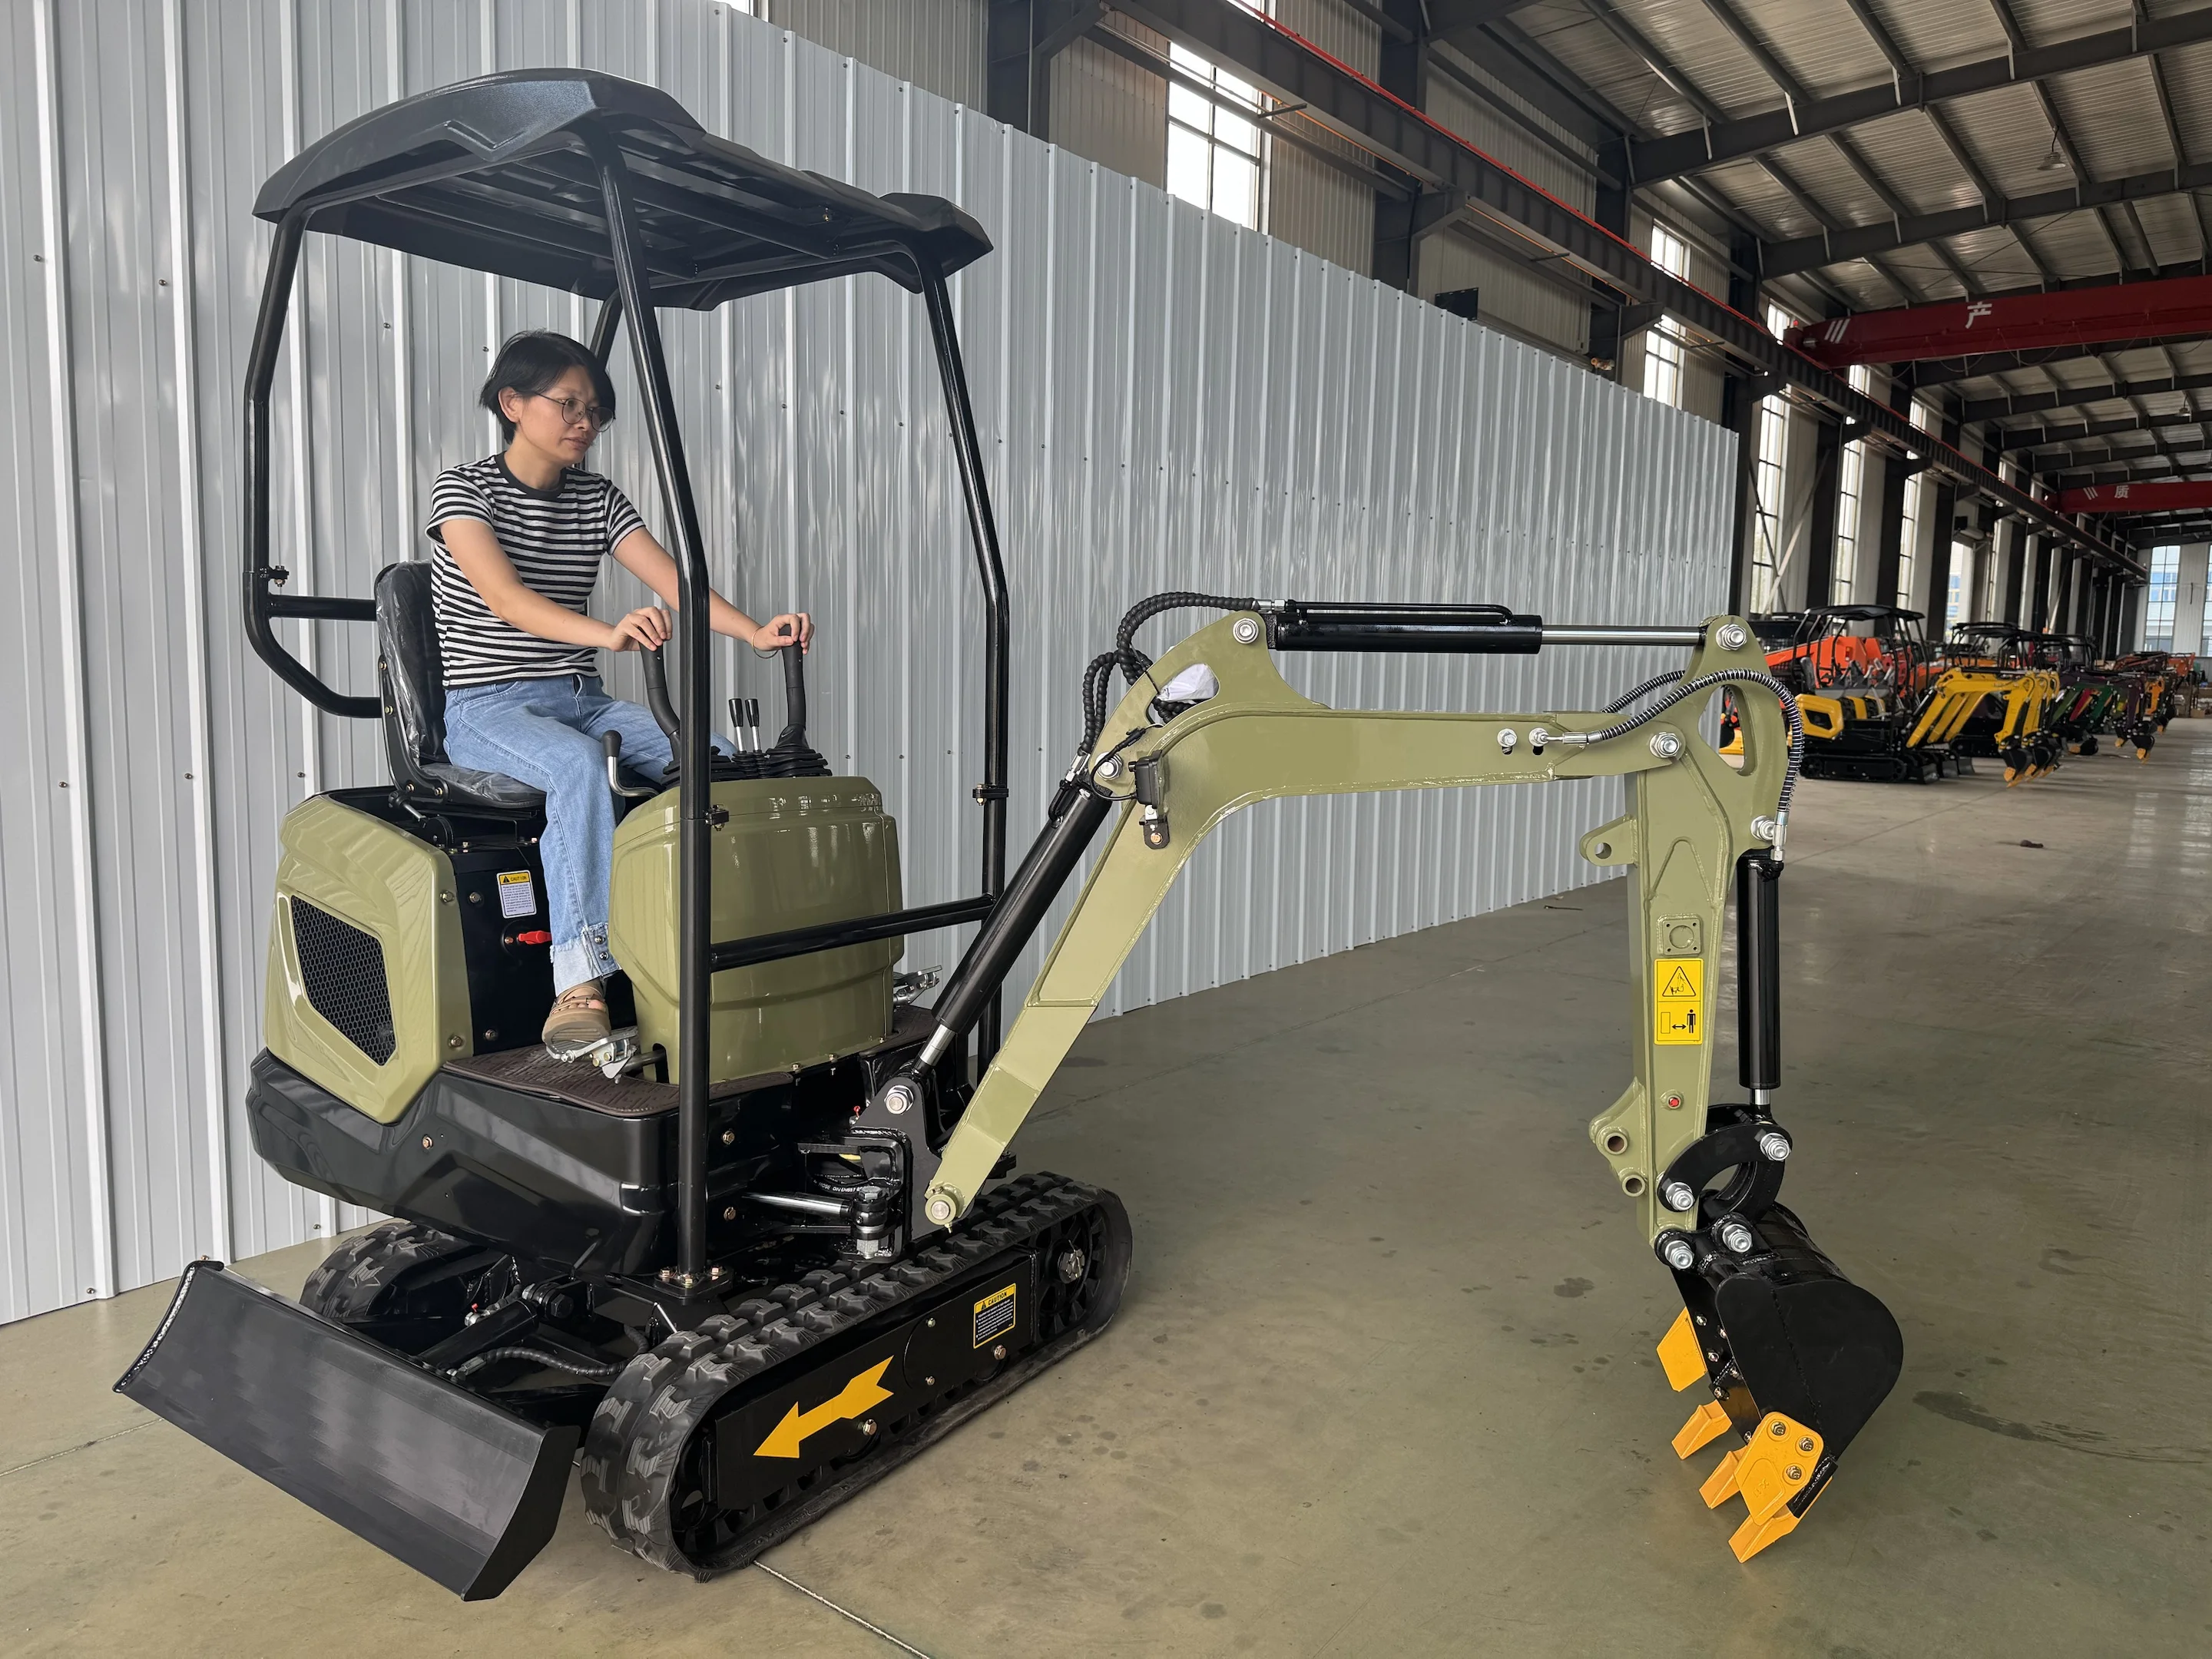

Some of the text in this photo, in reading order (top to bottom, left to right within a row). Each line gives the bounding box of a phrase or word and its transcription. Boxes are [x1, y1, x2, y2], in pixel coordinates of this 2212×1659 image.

[1965, 301, 1992, 329] 产
[2114, 485, 2130, 499] 质
[988, 1291, 1008, 1305] CAUTION
